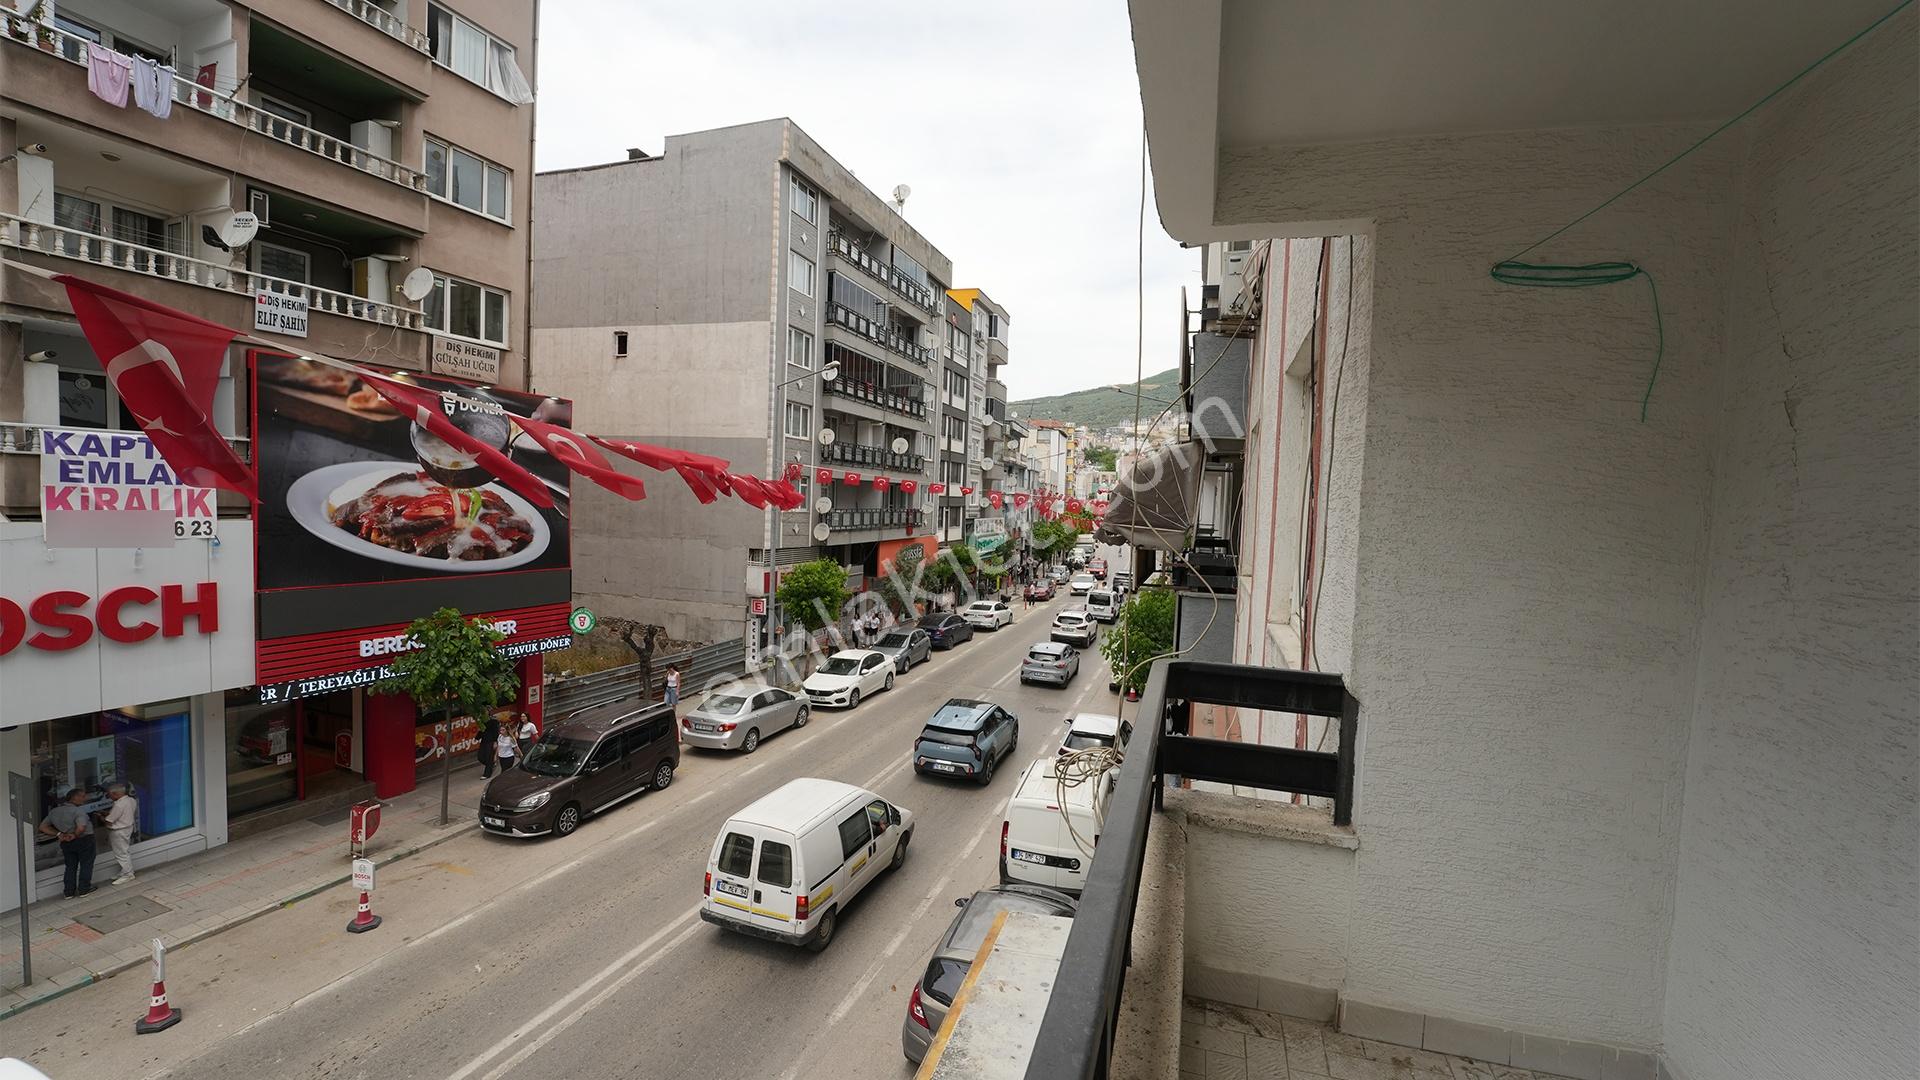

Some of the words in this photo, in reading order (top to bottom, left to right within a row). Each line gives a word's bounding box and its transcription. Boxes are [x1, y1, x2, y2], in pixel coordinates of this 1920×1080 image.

[257, 310, 279, 326] ELİF
[281, 314, 306, 332] ŞAHİN
[435, 352, 471, 368] GÜLŞAH
[473, 361, 496, 373] UĞUR
[43, 430, 167, 460] KAPT
[190, 520, 213, 537] 23
[755, 602, 762, 611] E
[360, 633, 426, 657] BEREK
[507, 642, 538, 657] TAVUK
[540, 636, 571, 651] DÖNER
[299, 670, 376, 694] TEREYAĞLI
